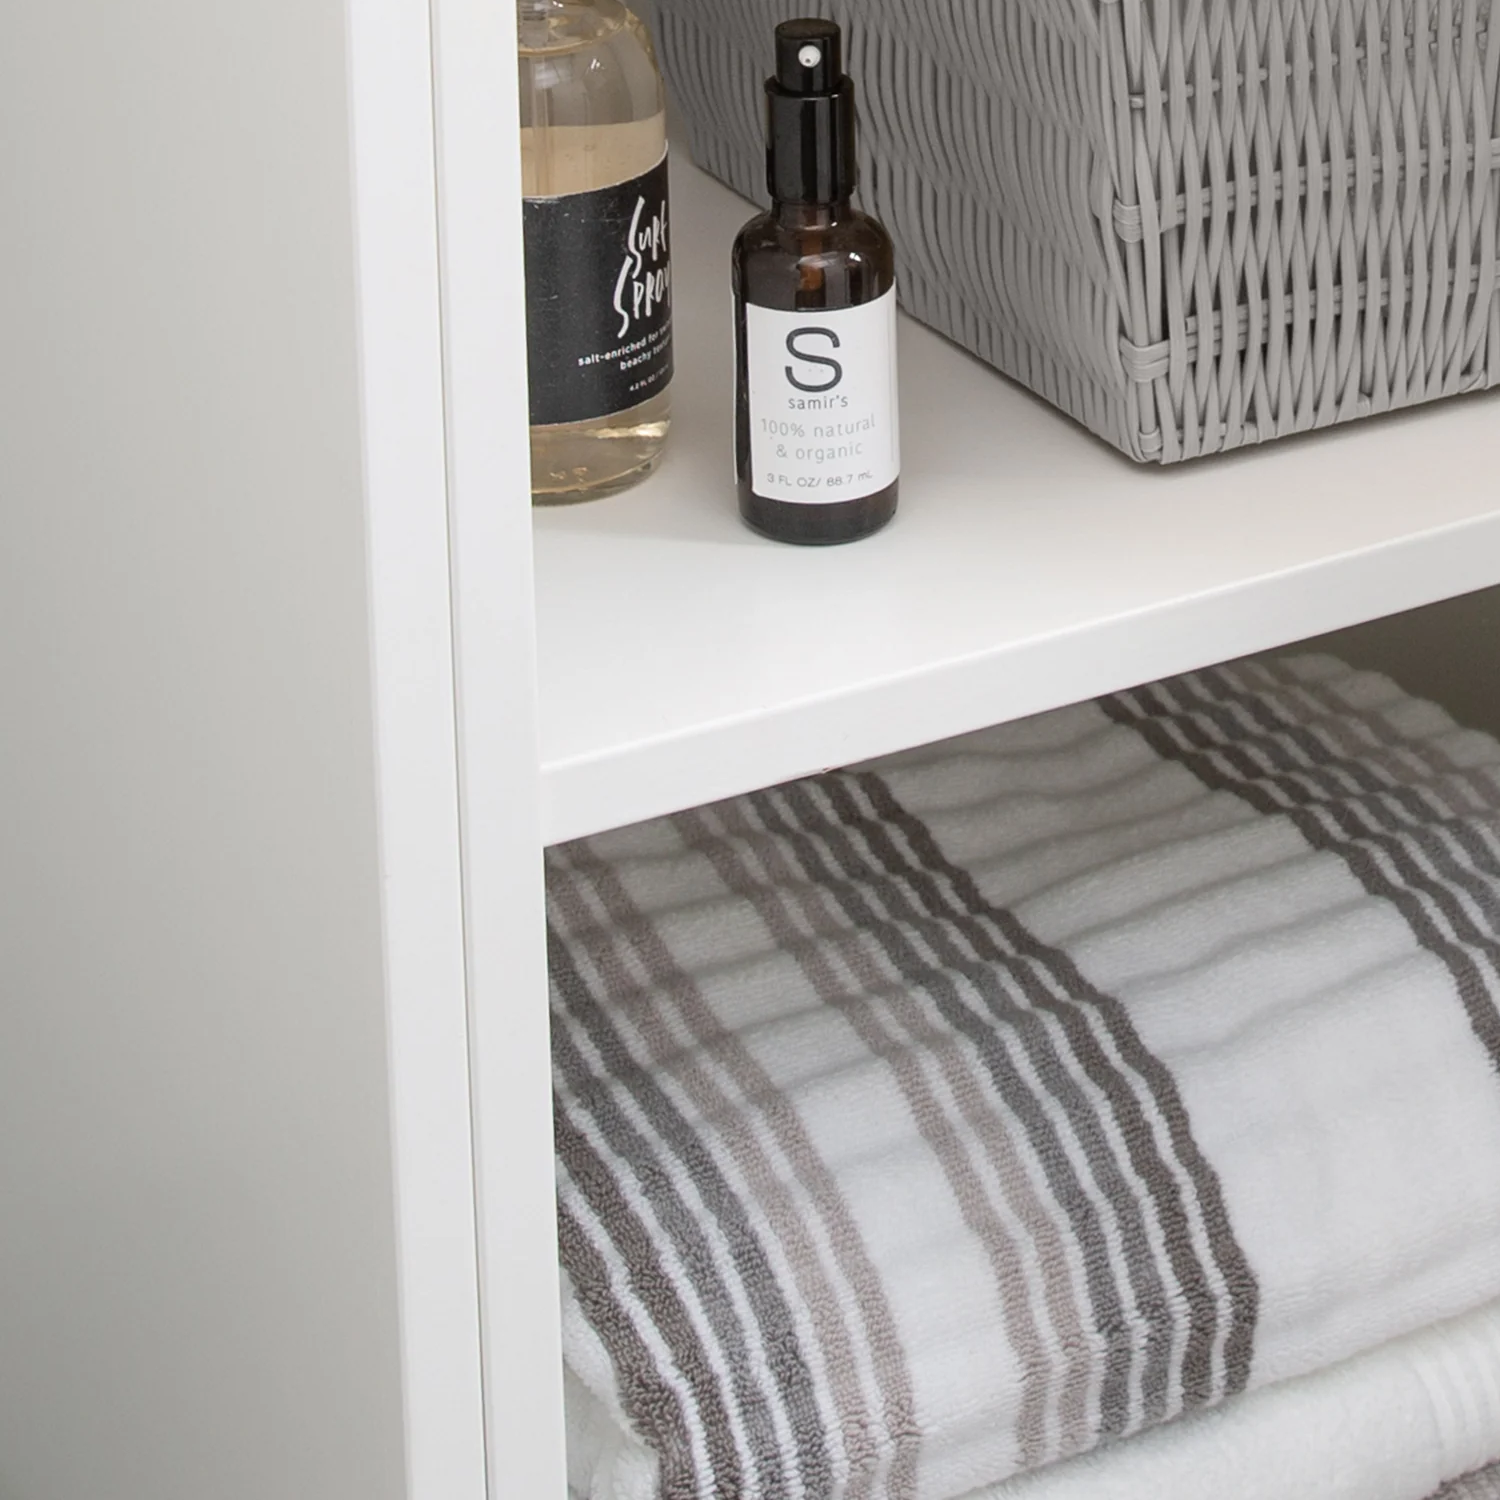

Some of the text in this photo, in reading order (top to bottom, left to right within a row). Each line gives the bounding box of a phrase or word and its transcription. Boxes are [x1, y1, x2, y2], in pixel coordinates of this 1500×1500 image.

[577, 336, 647, 367] salt-enriched
[619, 349, 652, 371] beachy
[785, 326, 843, 393] S
[788, 394, 849, 410] samir's
[761, 413, 876, 438] 100% natural
[776, 441, 863, 464] & organic
[767, 472, 775, 484] 3
[779, 474, 793, 487] FL
